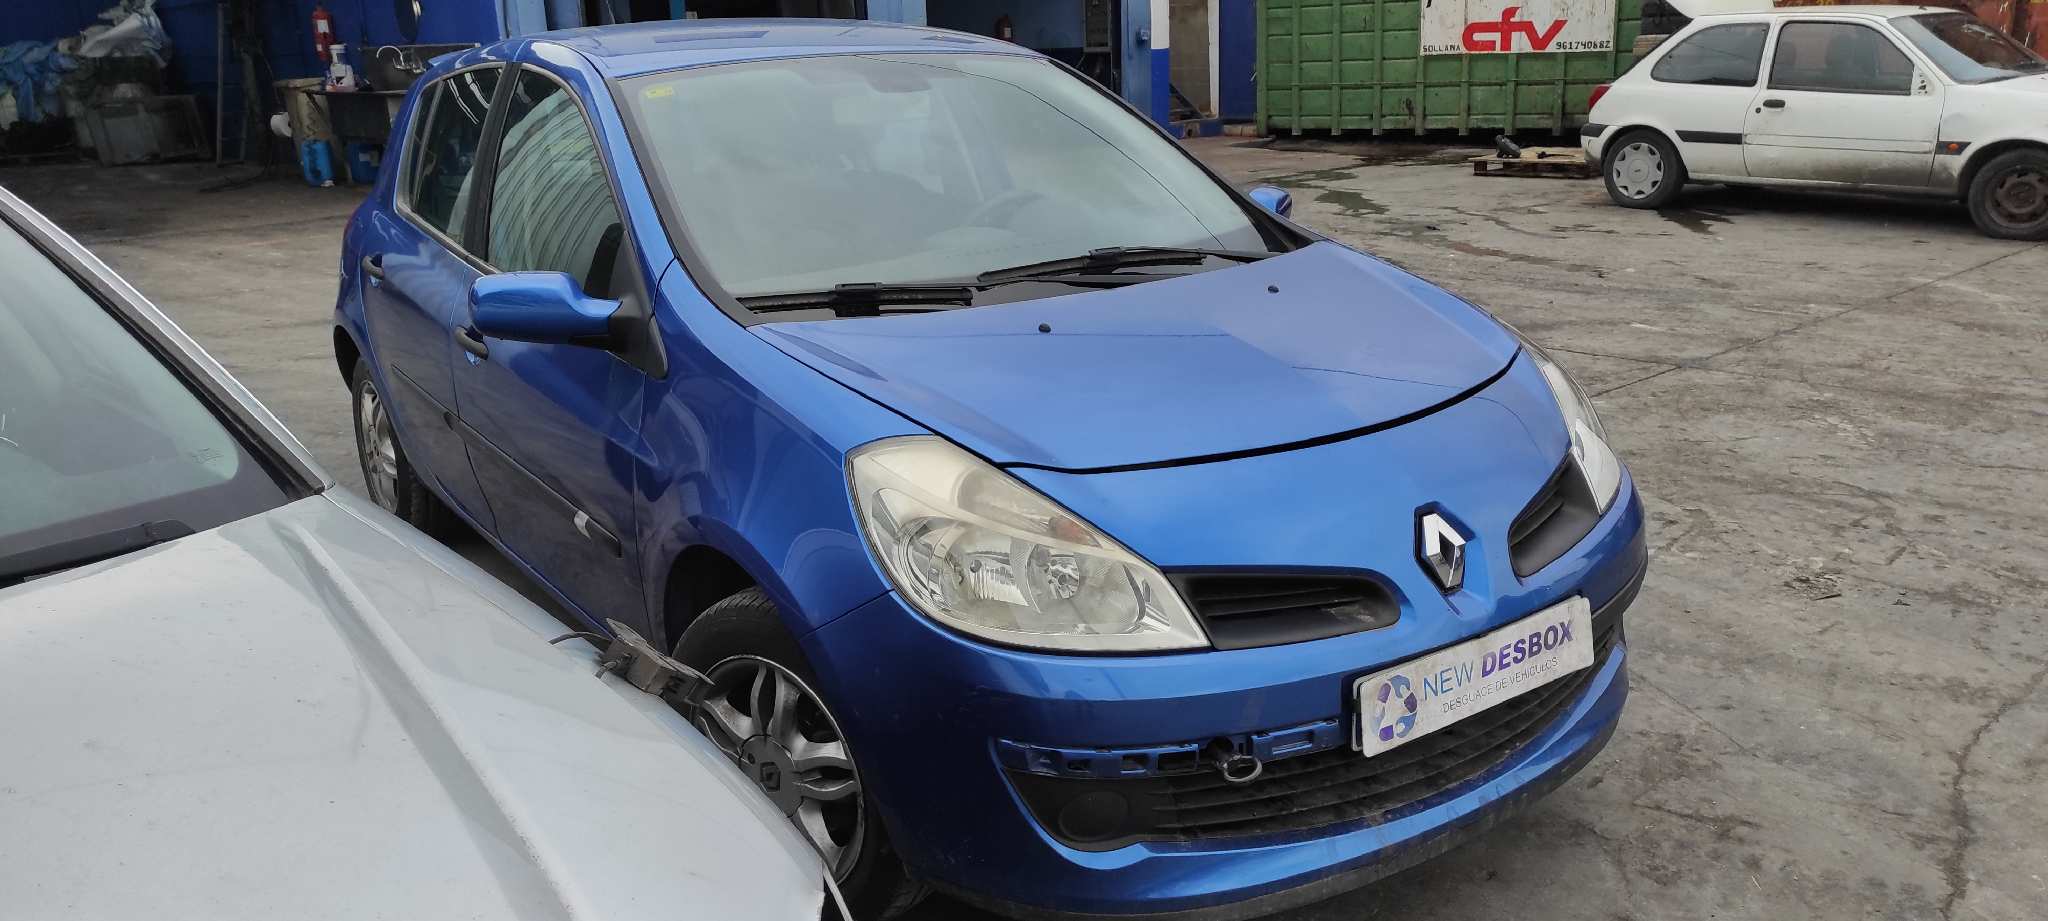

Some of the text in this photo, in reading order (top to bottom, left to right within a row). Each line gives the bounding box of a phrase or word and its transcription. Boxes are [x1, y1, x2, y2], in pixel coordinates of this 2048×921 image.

[1422, 44, 1461, 53] SOLLANA
[1423, 621, 1573, 700] NEW DESBOX
[1442, 683, 1494, 713] DESGUACE
[1495, 679, 1509, 690] DE
